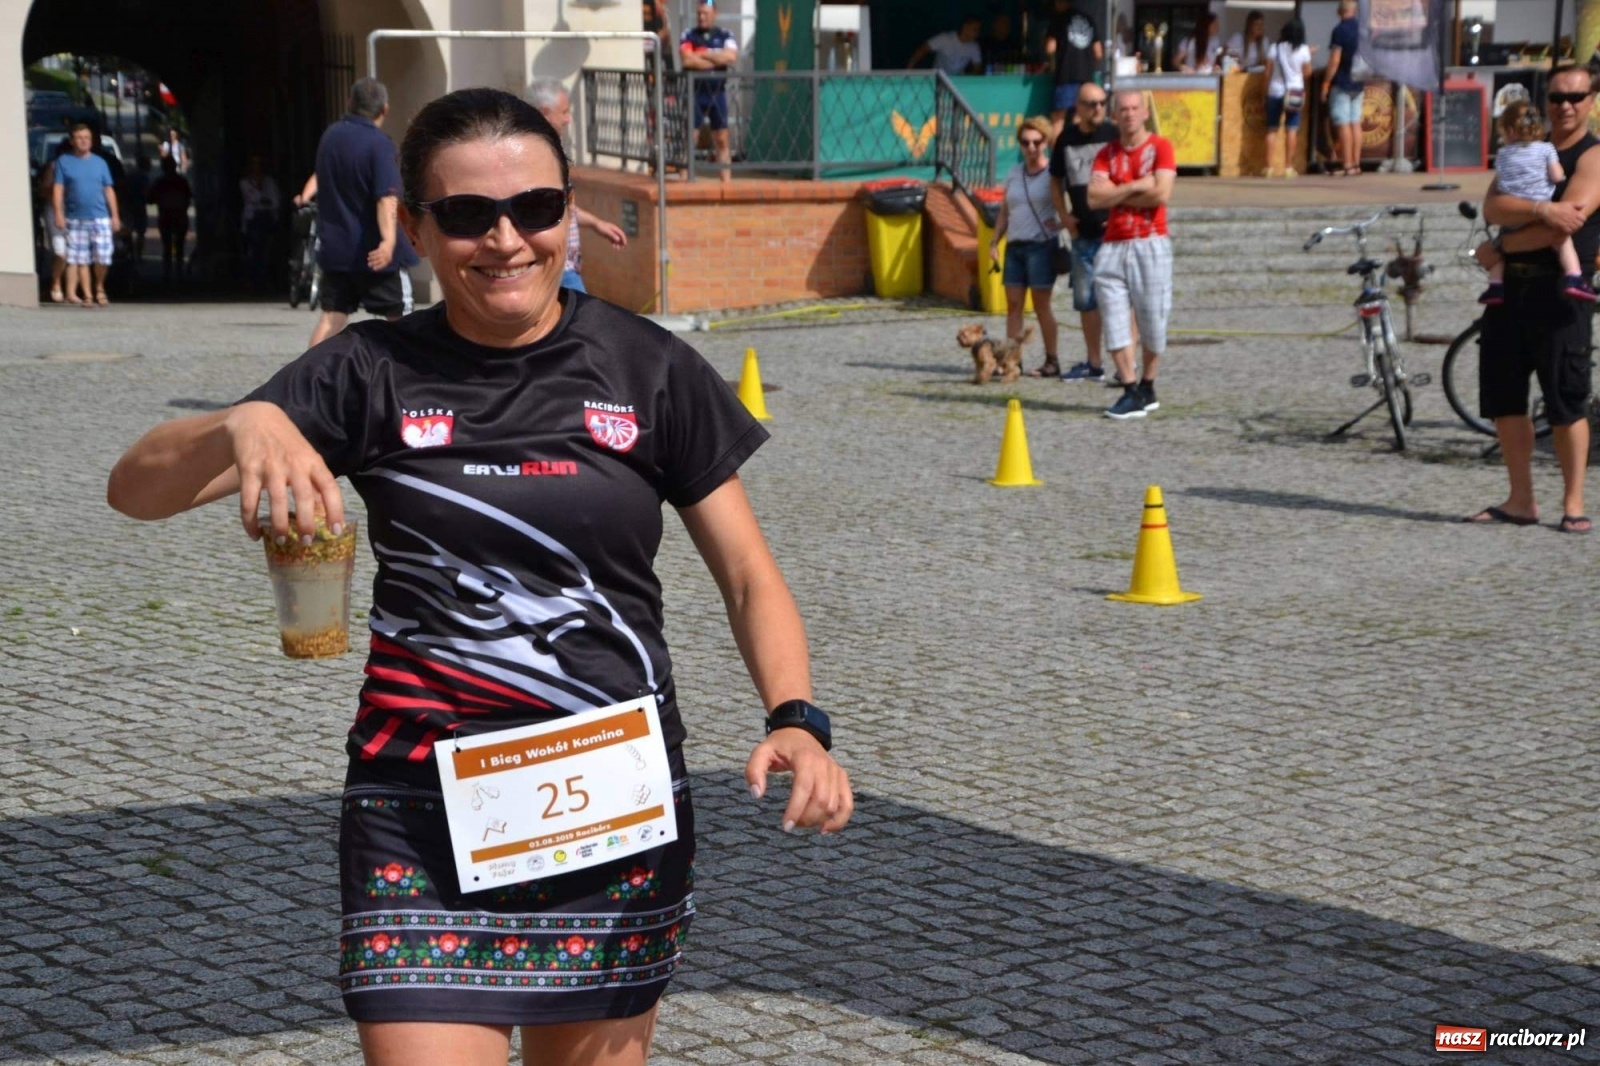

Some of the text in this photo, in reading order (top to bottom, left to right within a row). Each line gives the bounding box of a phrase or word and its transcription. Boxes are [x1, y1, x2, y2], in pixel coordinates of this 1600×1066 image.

[583, 400, 635, 413] RACIBÓRZ
[490, 752, 522, 767] Bieg
[525, 743, 569, 759] Wokół
[572, 728, 625, 747] Komina
[536, 774, 591, 820] 25
[576, 824, 611, 837] Racibórz
